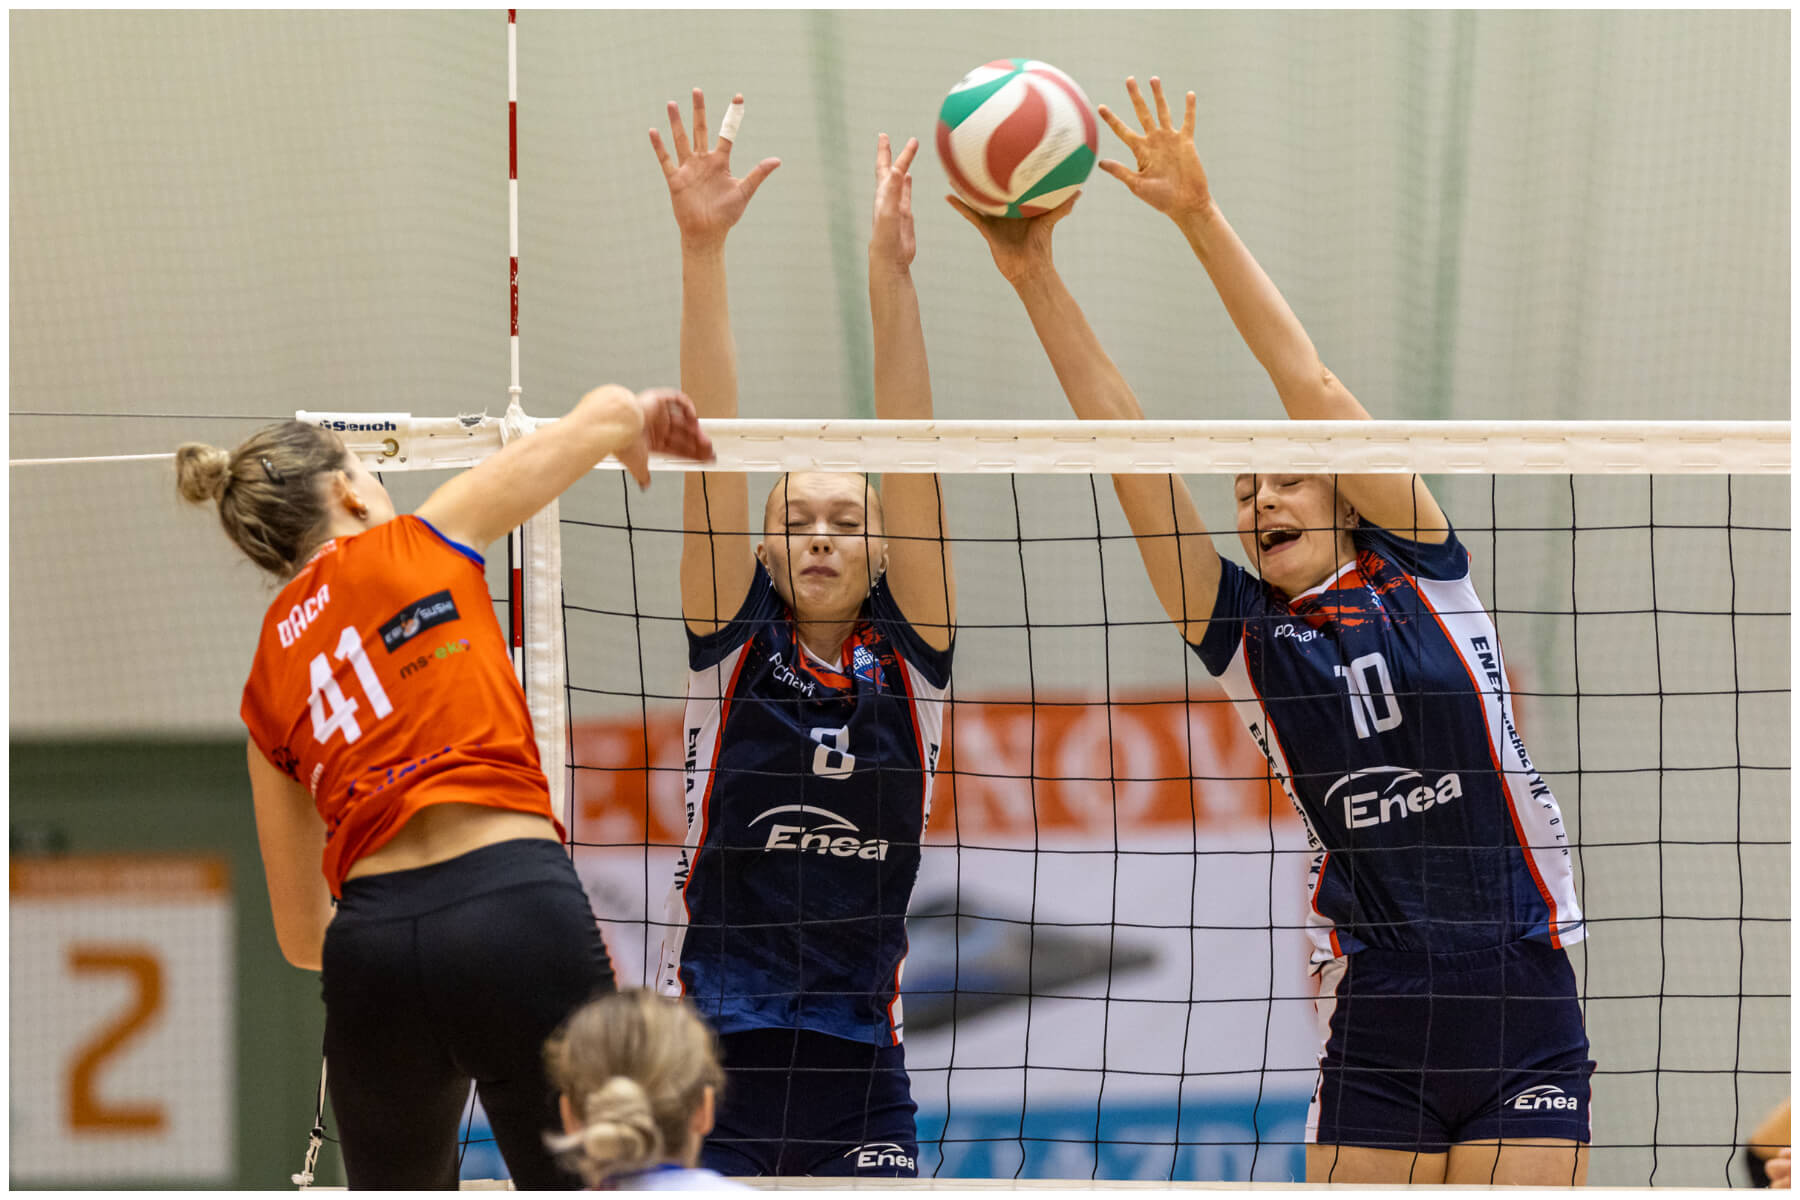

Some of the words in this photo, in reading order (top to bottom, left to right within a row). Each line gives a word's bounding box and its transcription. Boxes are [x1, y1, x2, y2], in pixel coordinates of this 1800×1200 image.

[307, 625, 394, 744] 41
[1334, 652, 1402, 739] 10
[810, 724, 856, 780] 8
[1343, 773, 1463, 829] Enea
[764, 824, 889, 861] Enea
[66, 943, 166, 1137] 2
[1514, 1094, 1578, 1111] Enea
[857, 1151, 915, 1171] Enea
